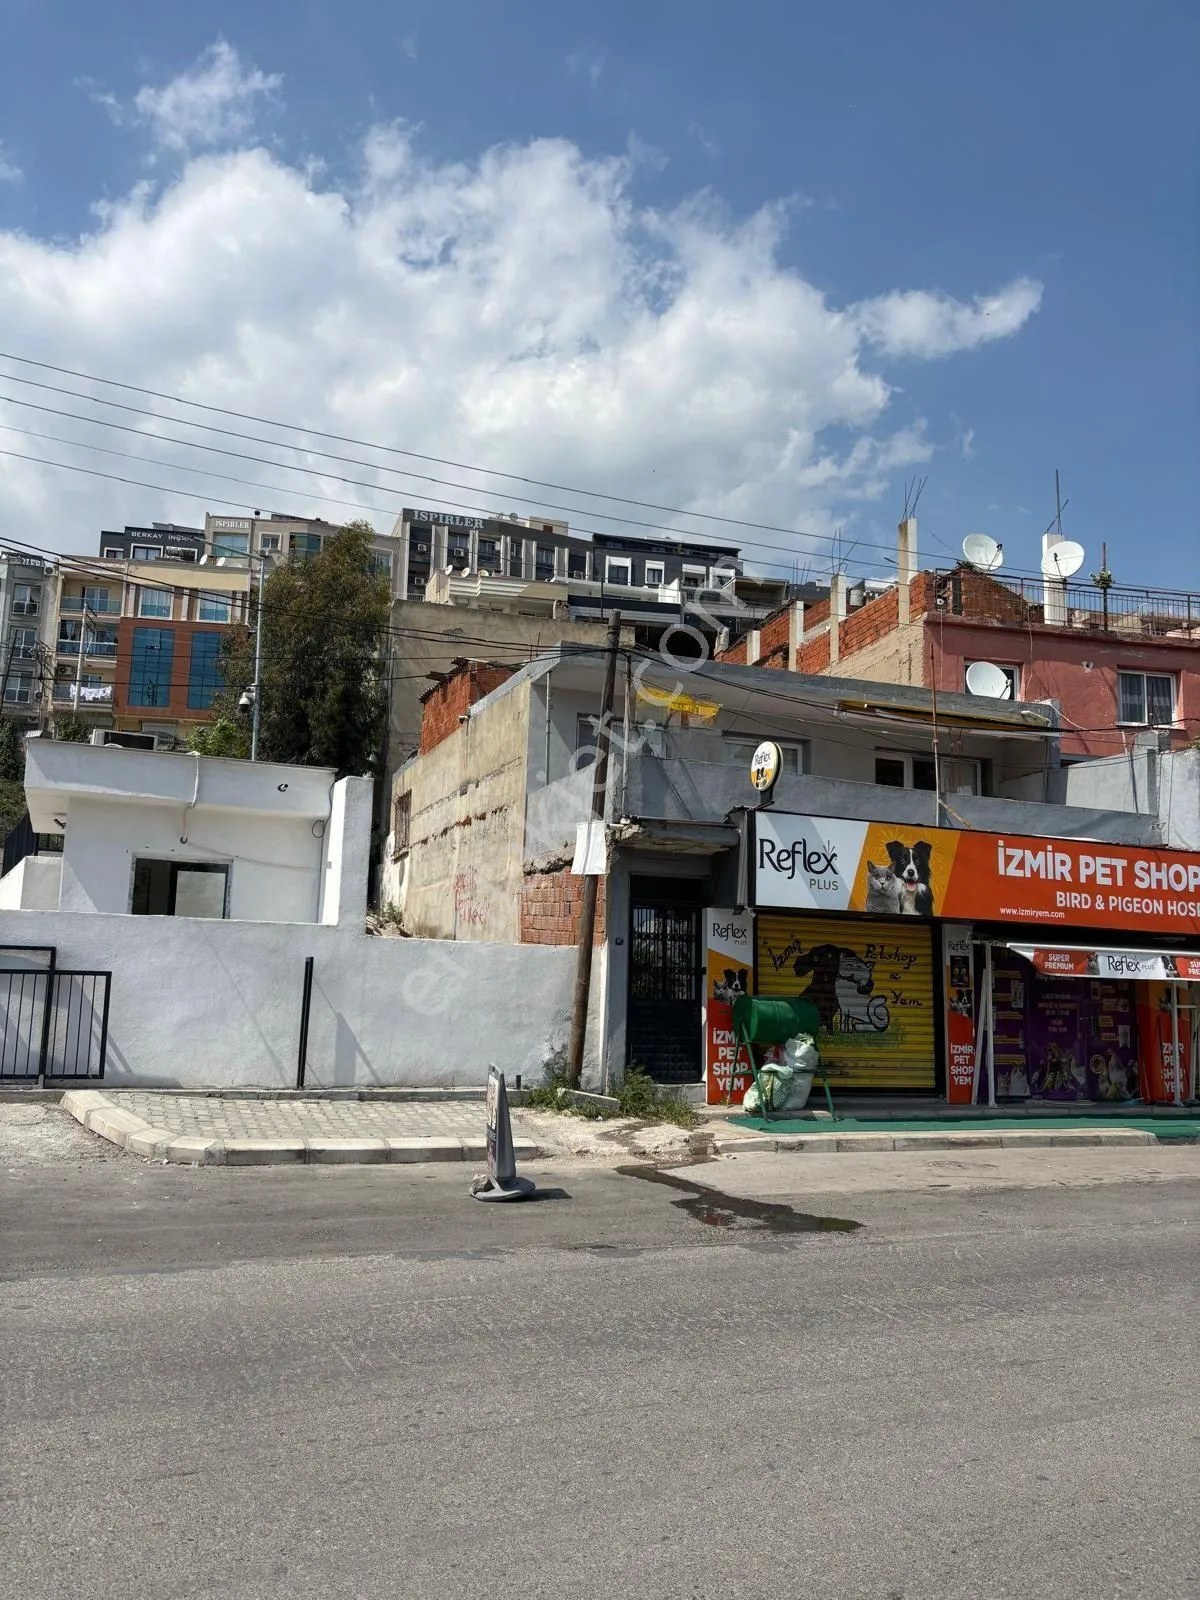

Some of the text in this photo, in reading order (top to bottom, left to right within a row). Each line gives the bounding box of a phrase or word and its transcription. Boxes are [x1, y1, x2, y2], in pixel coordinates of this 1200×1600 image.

[131, 531, 163, 540] BERKAY
[758, 838, 839, 880] Reflex
[998, 840, 1200, 893] İZMİR PET SHOP
[809, 877, 839, 891] PLUS
[1056, 891, 1091, 908] BIRD
[1095, 894, 1105, 910] &
[1109, 896, 1163, 915] PIGEON
[1000, 907, 1065, 919] www.izmiryem.com
[712, 922, 747, 942] Reflex
[1048, 953, 1070, 962] SUPER
[1045, 961, 1074, 970] PREMIUM
[1107, 955, 1141, 974] Reflex
[718, 1047, 743, 1060] PET
[950, 1042, 974, 1054] İZMİR
[954, 1055, 970, 1064] PET
[712, 1062, 749, 1077] SHOP
[950, 1065, 974, 1075] SHOP
[717, 1078, 744, 1091] YEM
[953, 1076, 972, 1085] YEM
